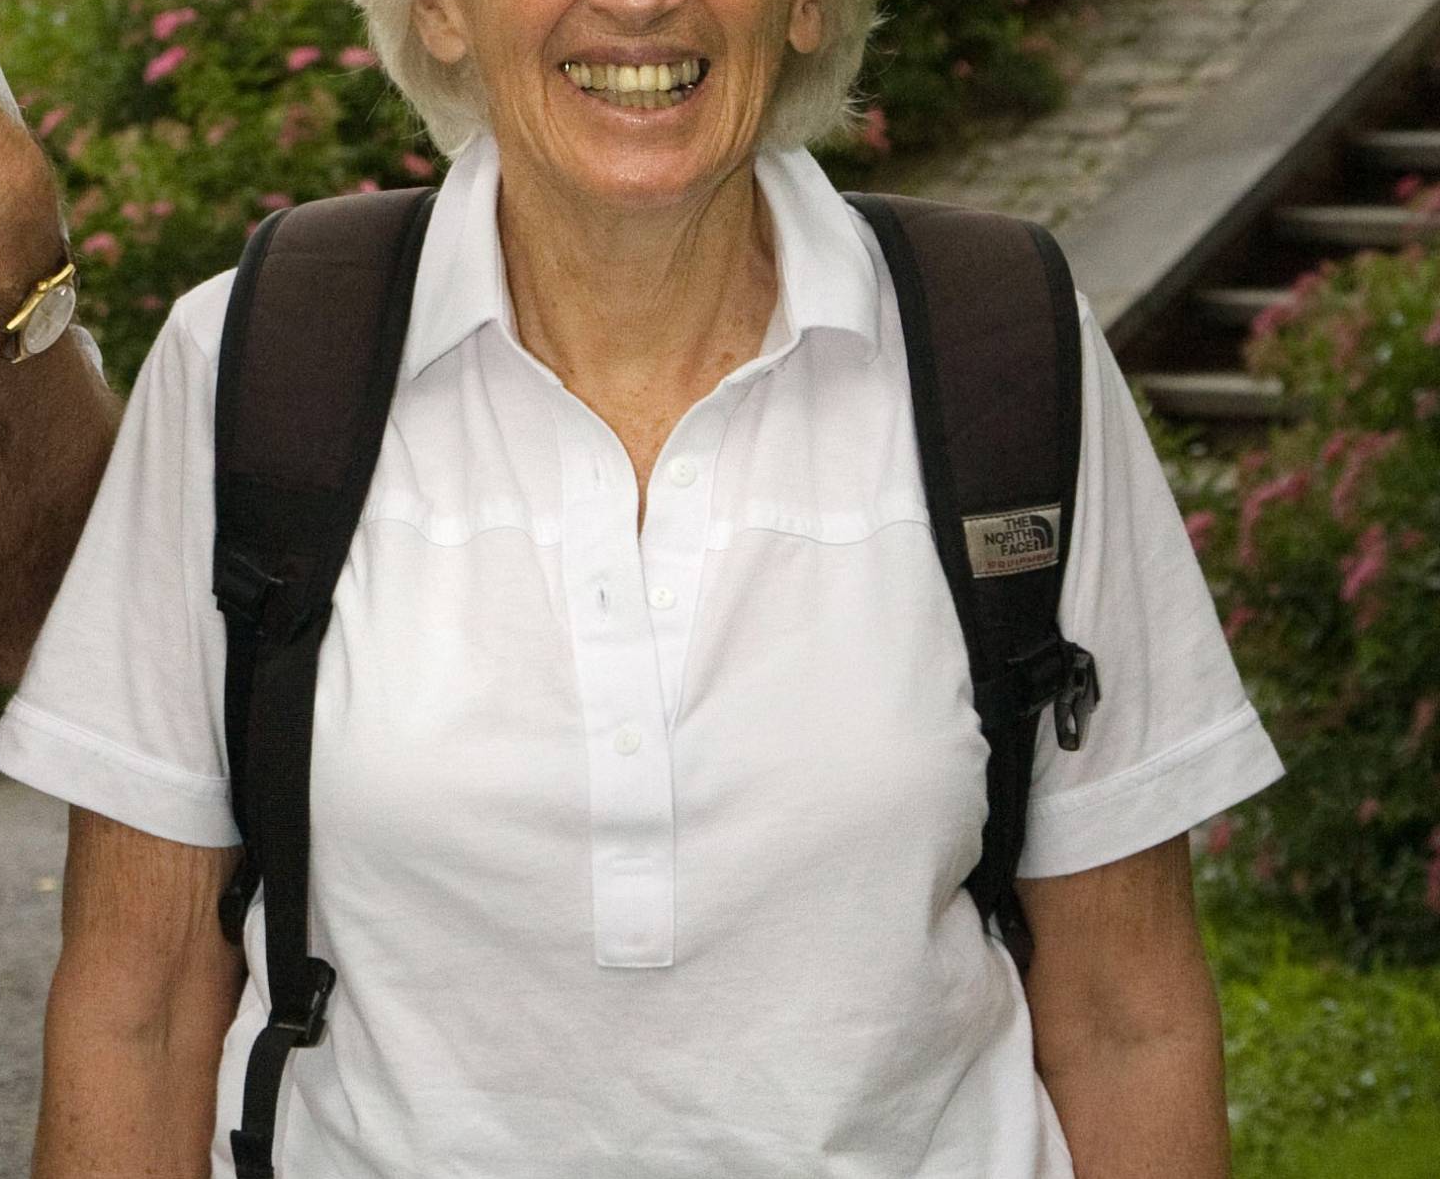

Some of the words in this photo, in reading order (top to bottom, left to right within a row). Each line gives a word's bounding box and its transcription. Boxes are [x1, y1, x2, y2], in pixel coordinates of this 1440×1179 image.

[1004, 516, 1030, 530] THE
[984, 529, 1033, 545] NORTH
[1001, 540, 1034, 556] FACE
